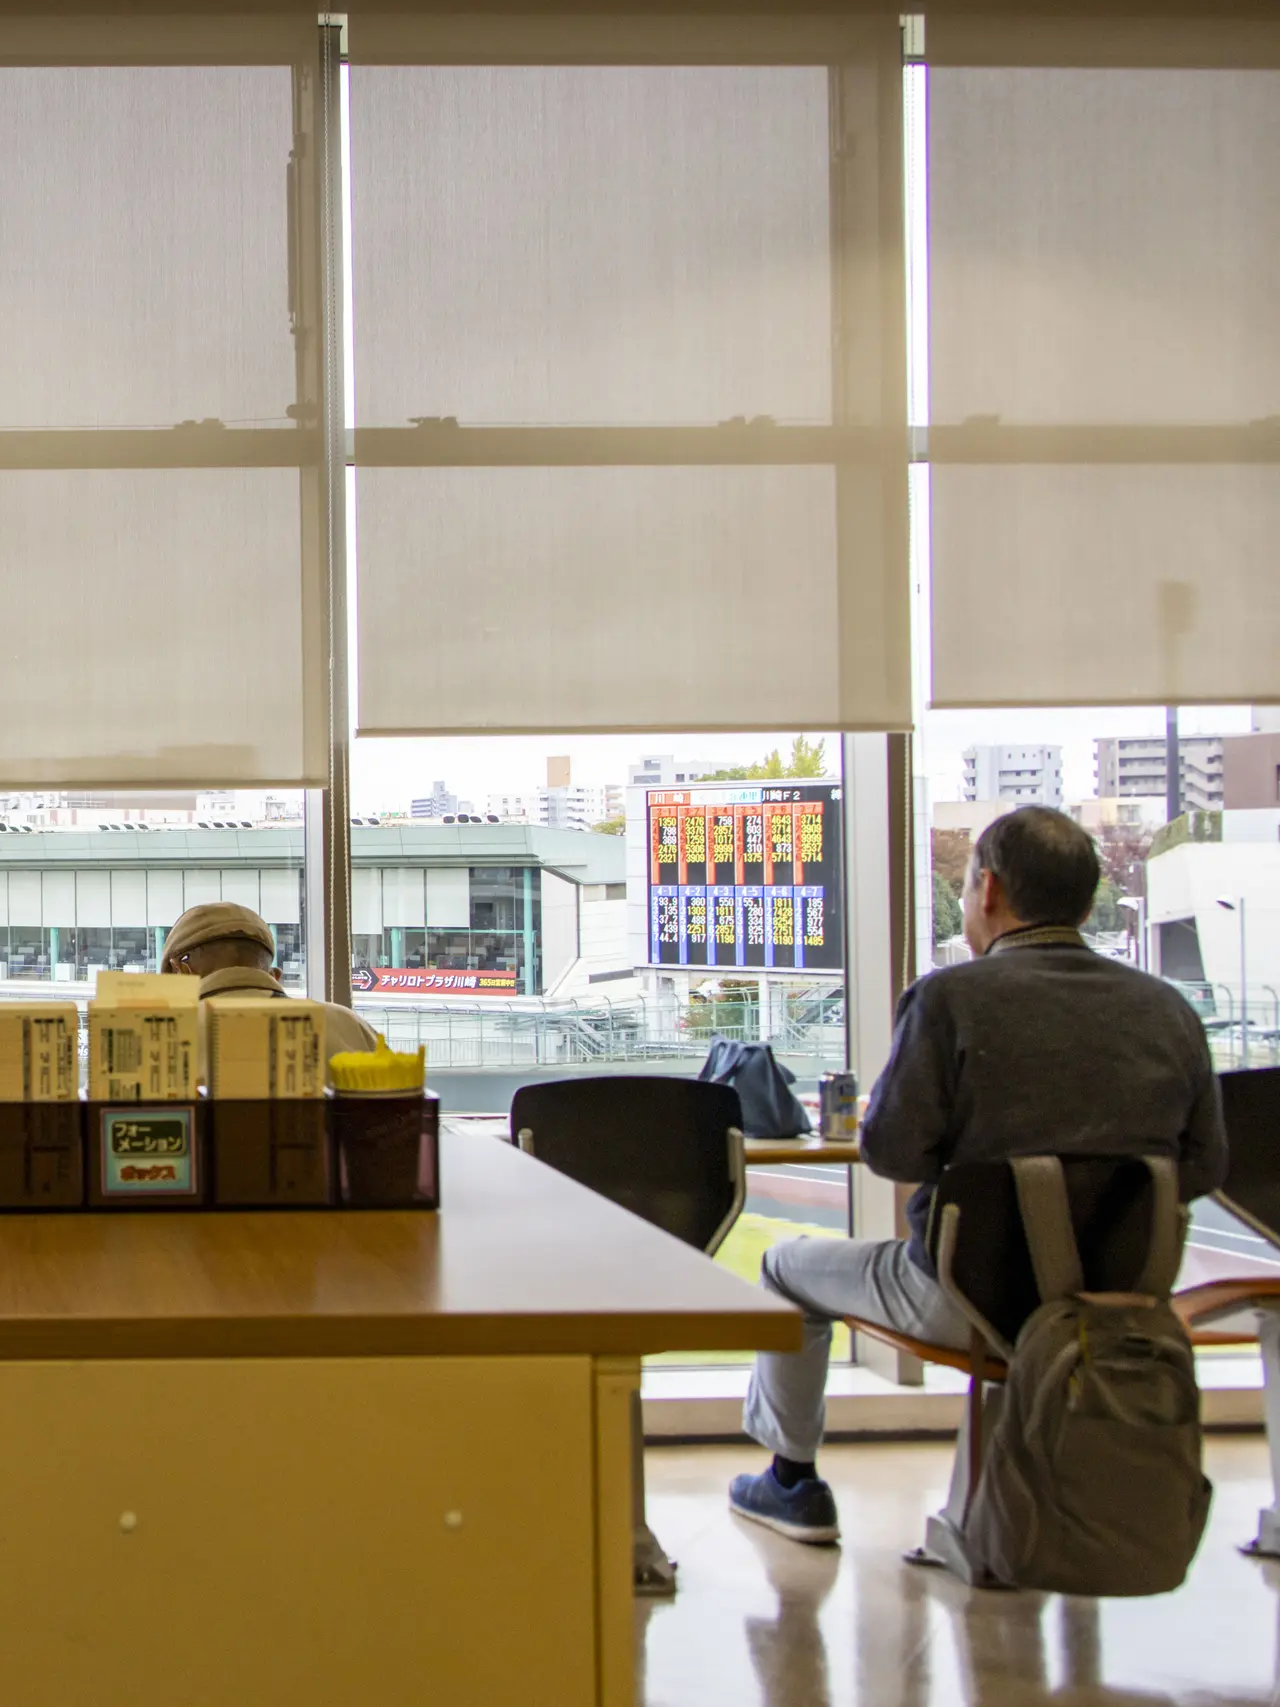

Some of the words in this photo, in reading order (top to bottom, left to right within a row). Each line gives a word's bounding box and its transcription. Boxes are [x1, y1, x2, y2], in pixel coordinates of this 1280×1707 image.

[381, 974, 476, 988] チャリロトプラザ川崎
[114, 1123, 152, 1138] フォー
[118, 1136, 182, 1152] メーション
